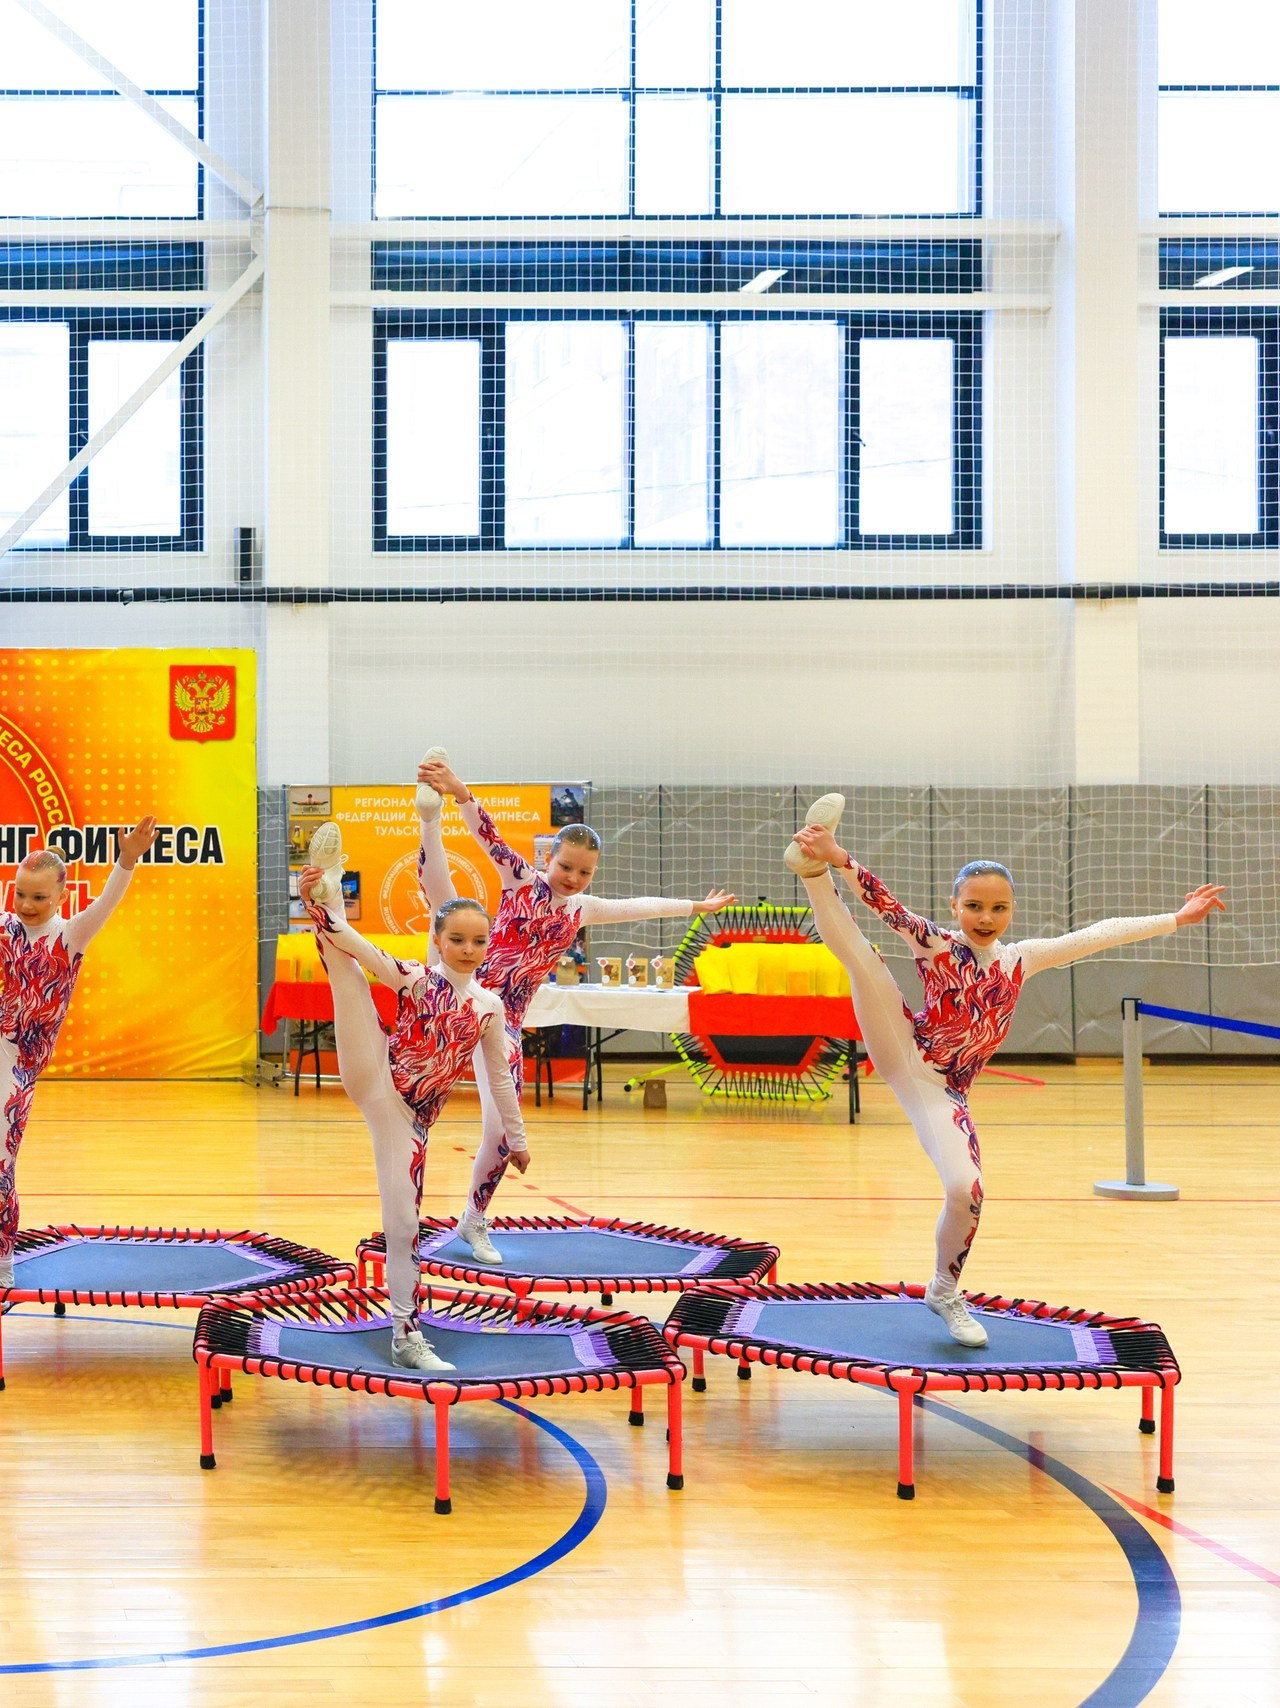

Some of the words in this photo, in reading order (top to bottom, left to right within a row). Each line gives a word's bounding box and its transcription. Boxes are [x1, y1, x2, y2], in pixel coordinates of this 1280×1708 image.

[28, 767, 65, 829] РОСС
[355, 797, 448, 808] РЕГИОНАЛЕ
[335, 812, 407, 822] ФЕДЕРАЦИИ
[375, 825, 420, 836] ТУЛЬСК
